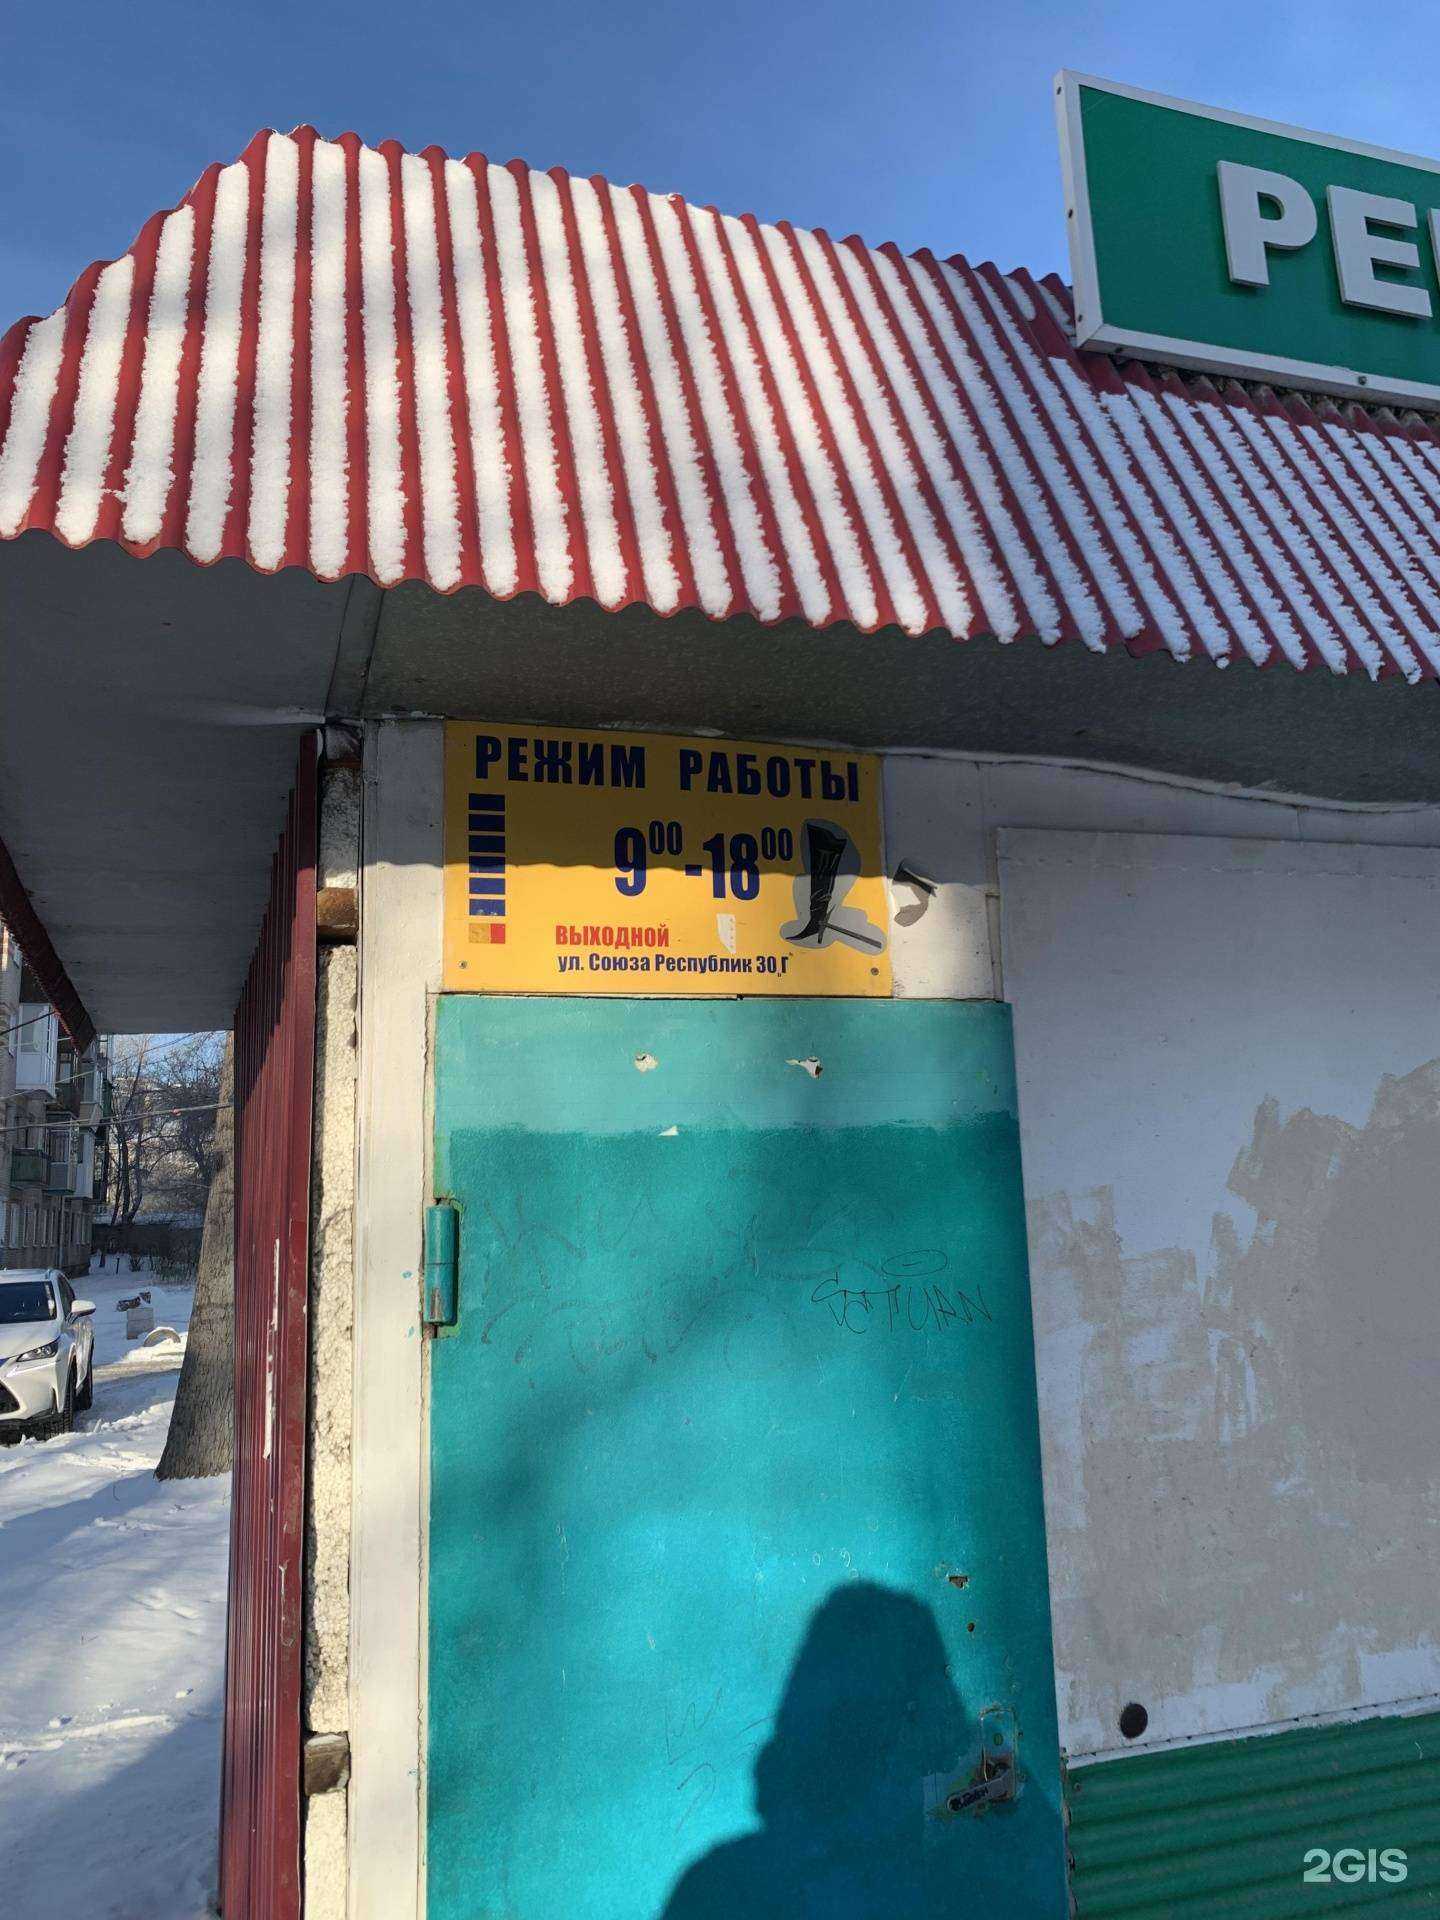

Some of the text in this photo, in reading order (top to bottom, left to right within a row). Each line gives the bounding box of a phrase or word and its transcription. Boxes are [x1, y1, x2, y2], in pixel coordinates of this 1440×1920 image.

[1216, 159, 1440, 320] РЕ
[475, 735, 860, 802] РЕЖИМ РАБОТЫ
[555, 923, 670, 948] ВЫХОДНОЙ
[558, 955, 585, 973] ул.
[588, 952, 651, 973] Союза
[654, 955, 752, 975] Республик
